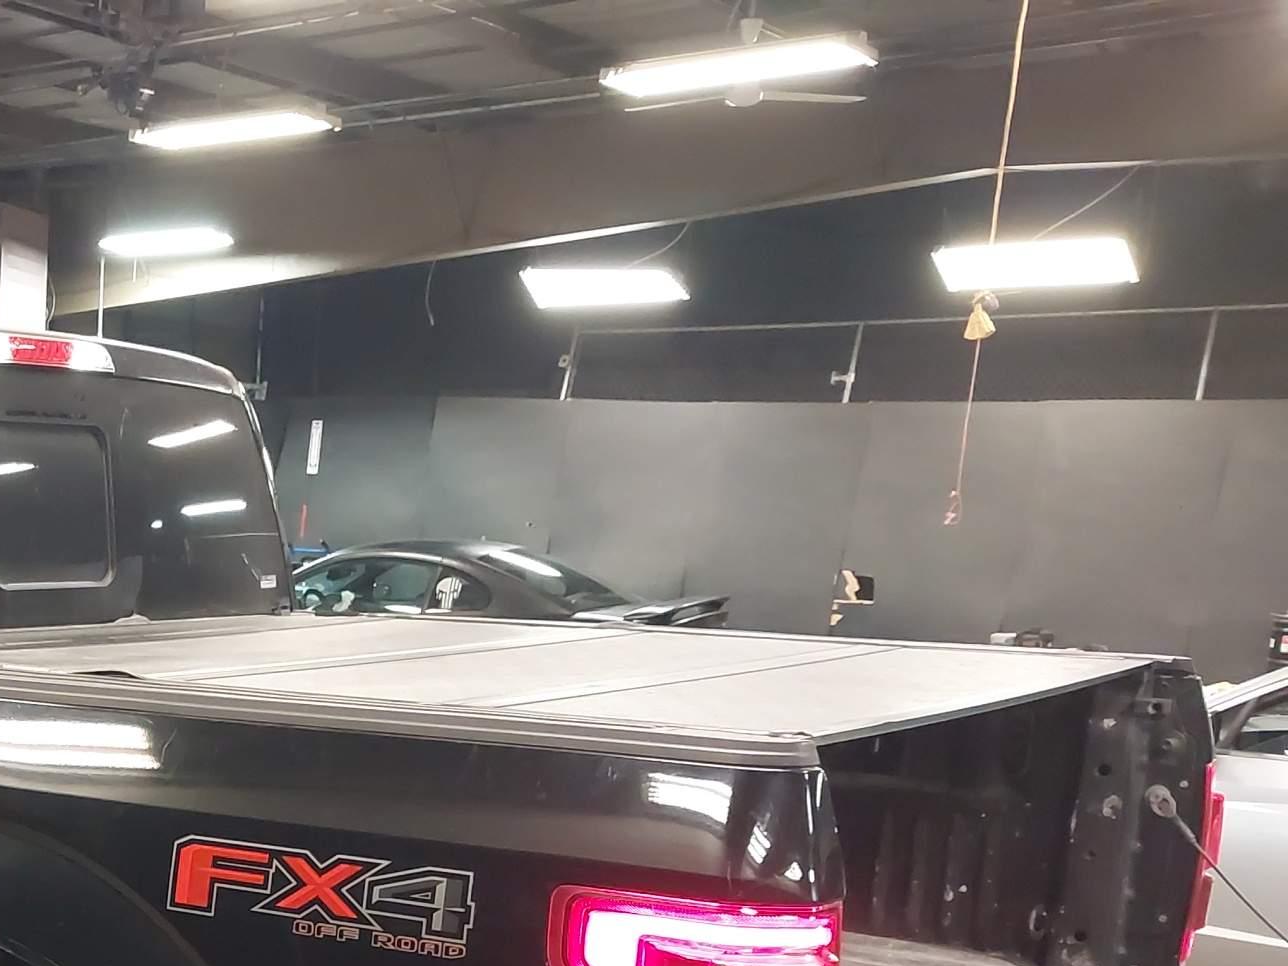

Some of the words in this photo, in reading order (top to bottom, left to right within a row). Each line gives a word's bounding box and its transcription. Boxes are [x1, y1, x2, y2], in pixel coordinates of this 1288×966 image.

[166, 834, 475, 944] FX4
[292, 919, 360, 942] OFF
[371, 931, 466, 959] ROAD
